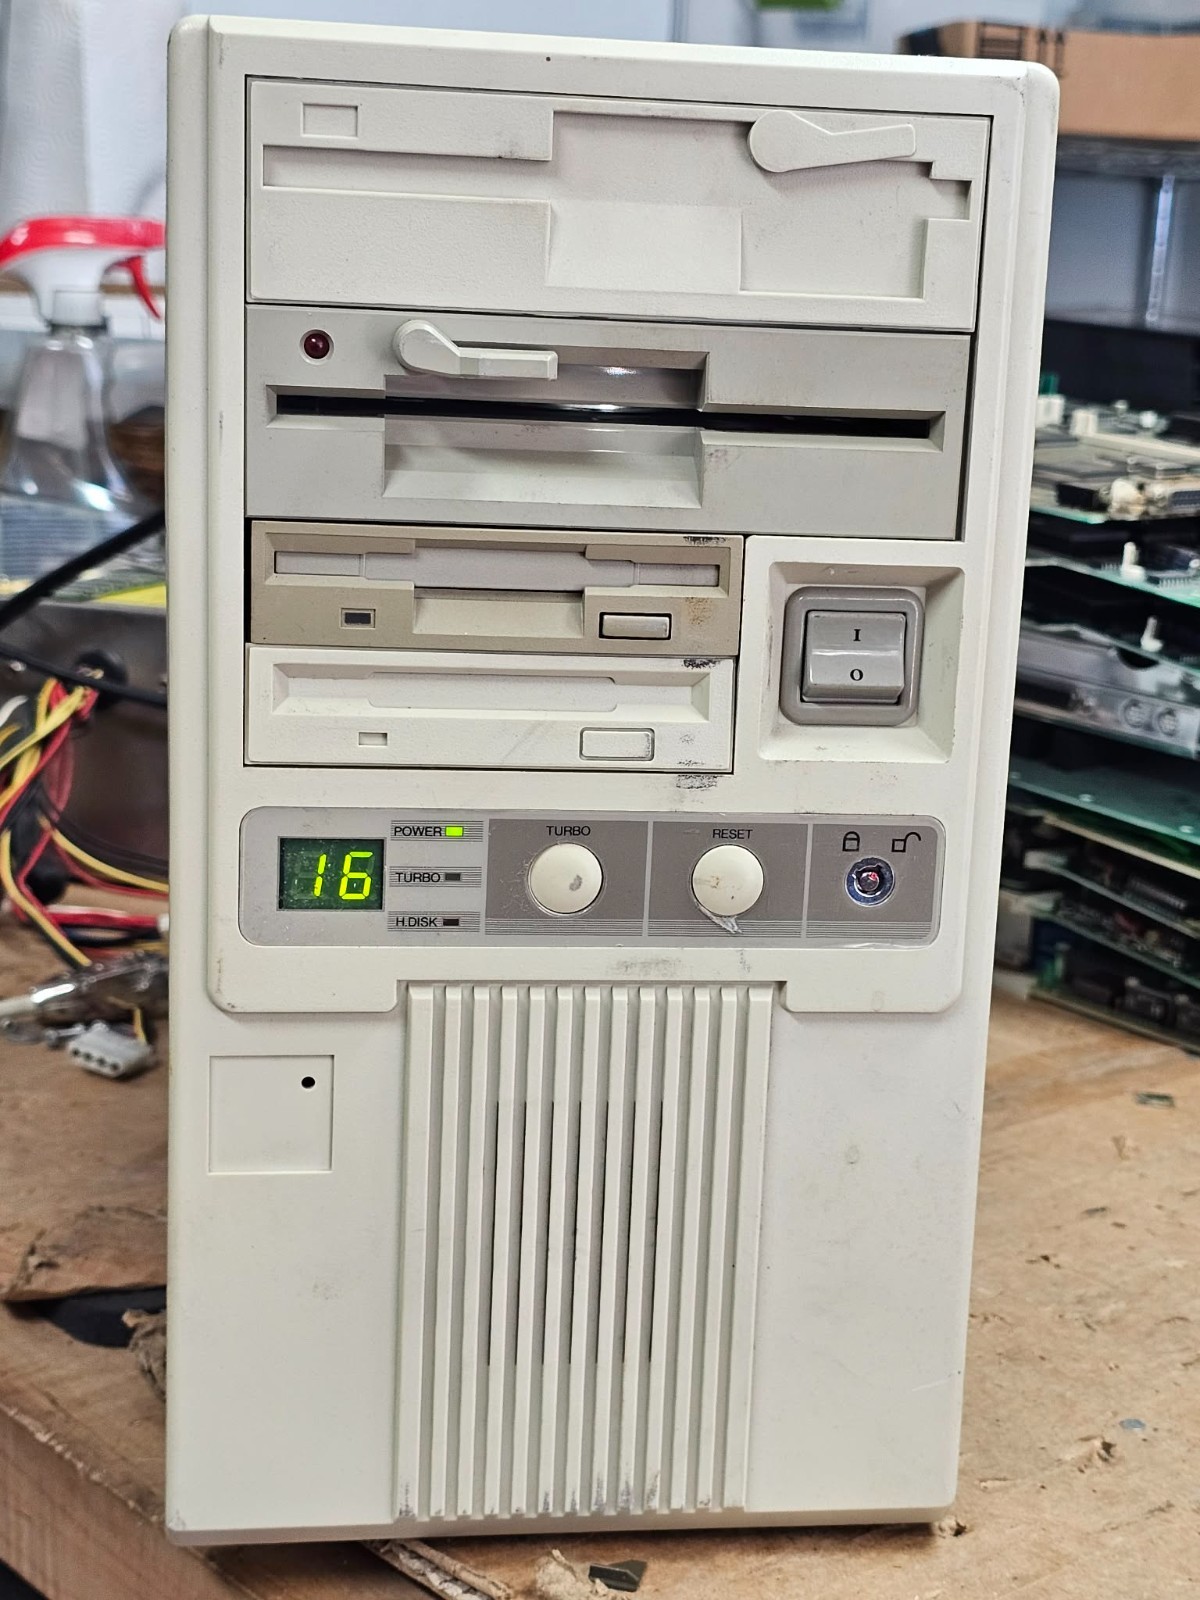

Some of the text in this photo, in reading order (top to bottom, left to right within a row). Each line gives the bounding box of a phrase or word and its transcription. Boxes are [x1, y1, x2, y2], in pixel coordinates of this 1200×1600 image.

[393, 825, 443, 837] POWER
[546, 825, 591, 836] TURBO
[712, 828, 753, 840] RESET
[313, 851, 374, 900] 16
[395, 872, 441, 883] TURBO
[395, 917, 438, 928] H.DISK
